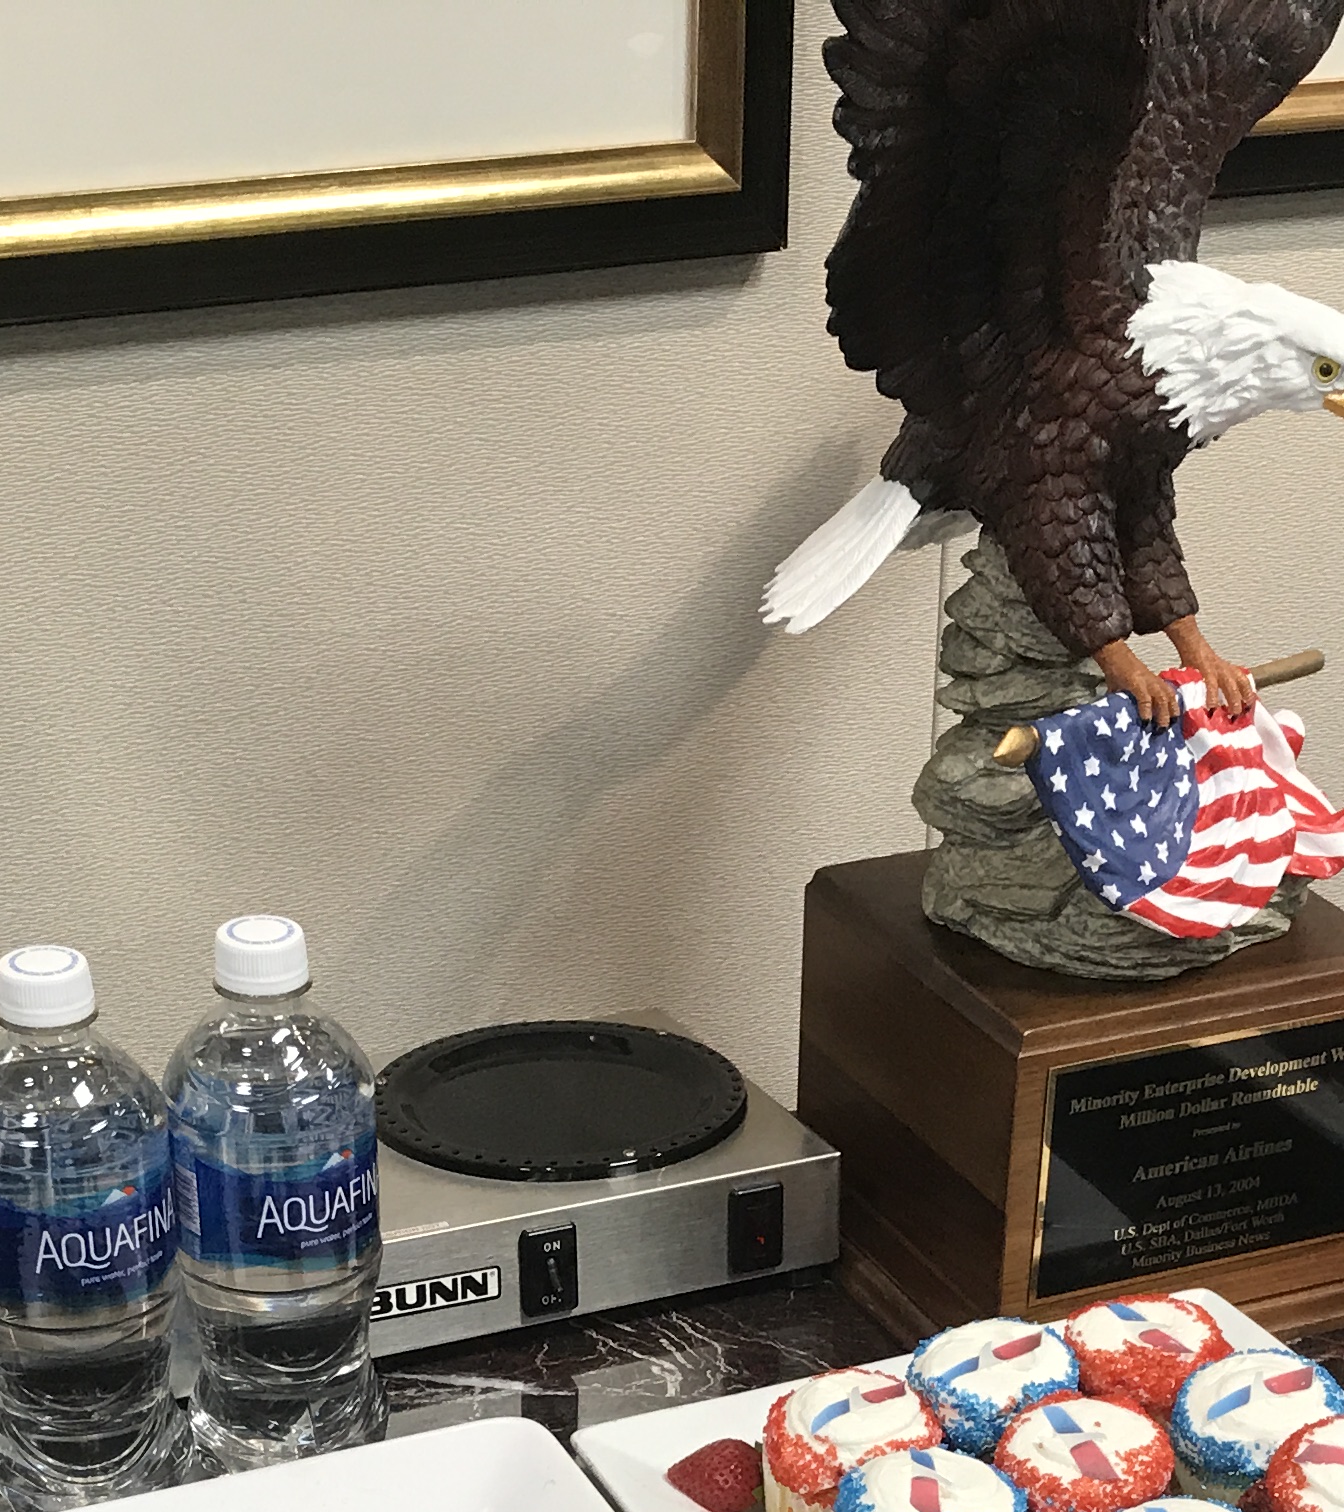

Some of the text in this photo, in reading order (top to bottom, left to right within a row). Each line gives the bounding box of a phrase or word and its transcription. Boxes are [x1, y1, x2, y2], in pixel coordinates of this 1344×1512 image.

[1068, 1089, 1140, 1115] Minority
[1144, 1072, 1225, 1100] Enterprise
[1228, 1051, 1327, 1083] Development
[1119, 1077, 1319, 1130] Million Dollar Roundtable
[1131, 1138, 1294, 1183] American Airlines
[256, 1162, 380, 1239] AQUAFIN
[1156, 1188, 1202, 1210] August
[1207, 1183, 1225, 1199] 13,
[35, 1187, 176, 1274] AQUAFINA
[1113, 1225, 1139, 1241] U.S.
[1173, 1214, 1188, 1229] of
[1188, 1204, 1254, 1225] Commerce,
[1121, 1242, 1146, 1256] U.S.
[1251, 1210, 1285, 1229] Worth
[543, 1240, 561, 1253] ON
[1131, 1230, 1271, 1269] Minority Business News
[370, 1272, 489, 1315] BUNN
